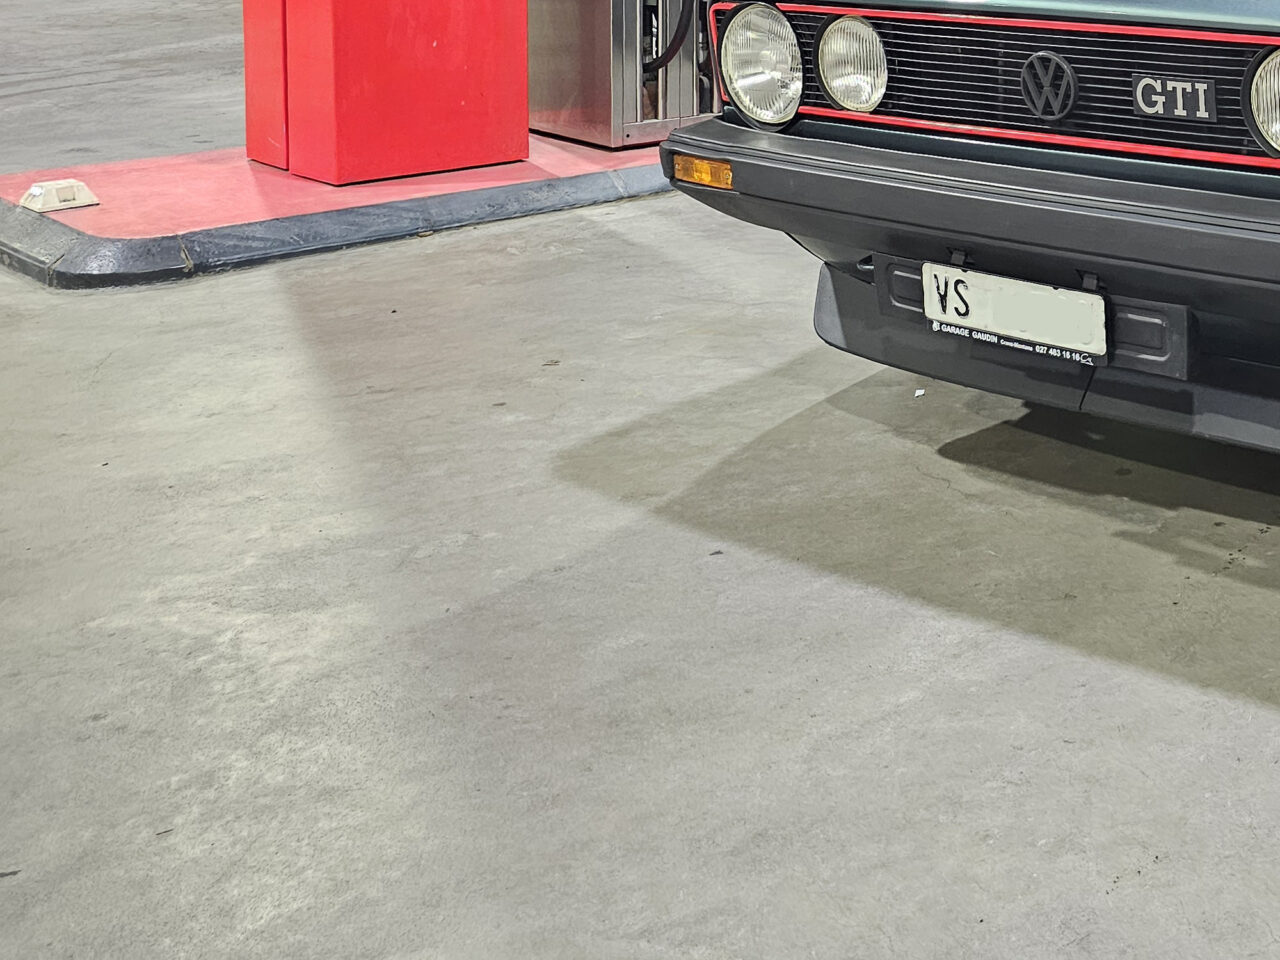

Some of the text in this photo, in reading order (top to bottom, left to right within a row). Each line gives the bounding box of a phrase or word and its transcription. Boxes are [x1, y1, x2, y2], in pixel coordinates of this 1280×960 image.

[1136, 77, 1209, 119] GTI
[933, 273, 970, 317] VS
[941, 324, 970, 338] GARAGE
[972, 331, 998, 344] GAUDIN
[1035, 344, 1048, 354] 027
